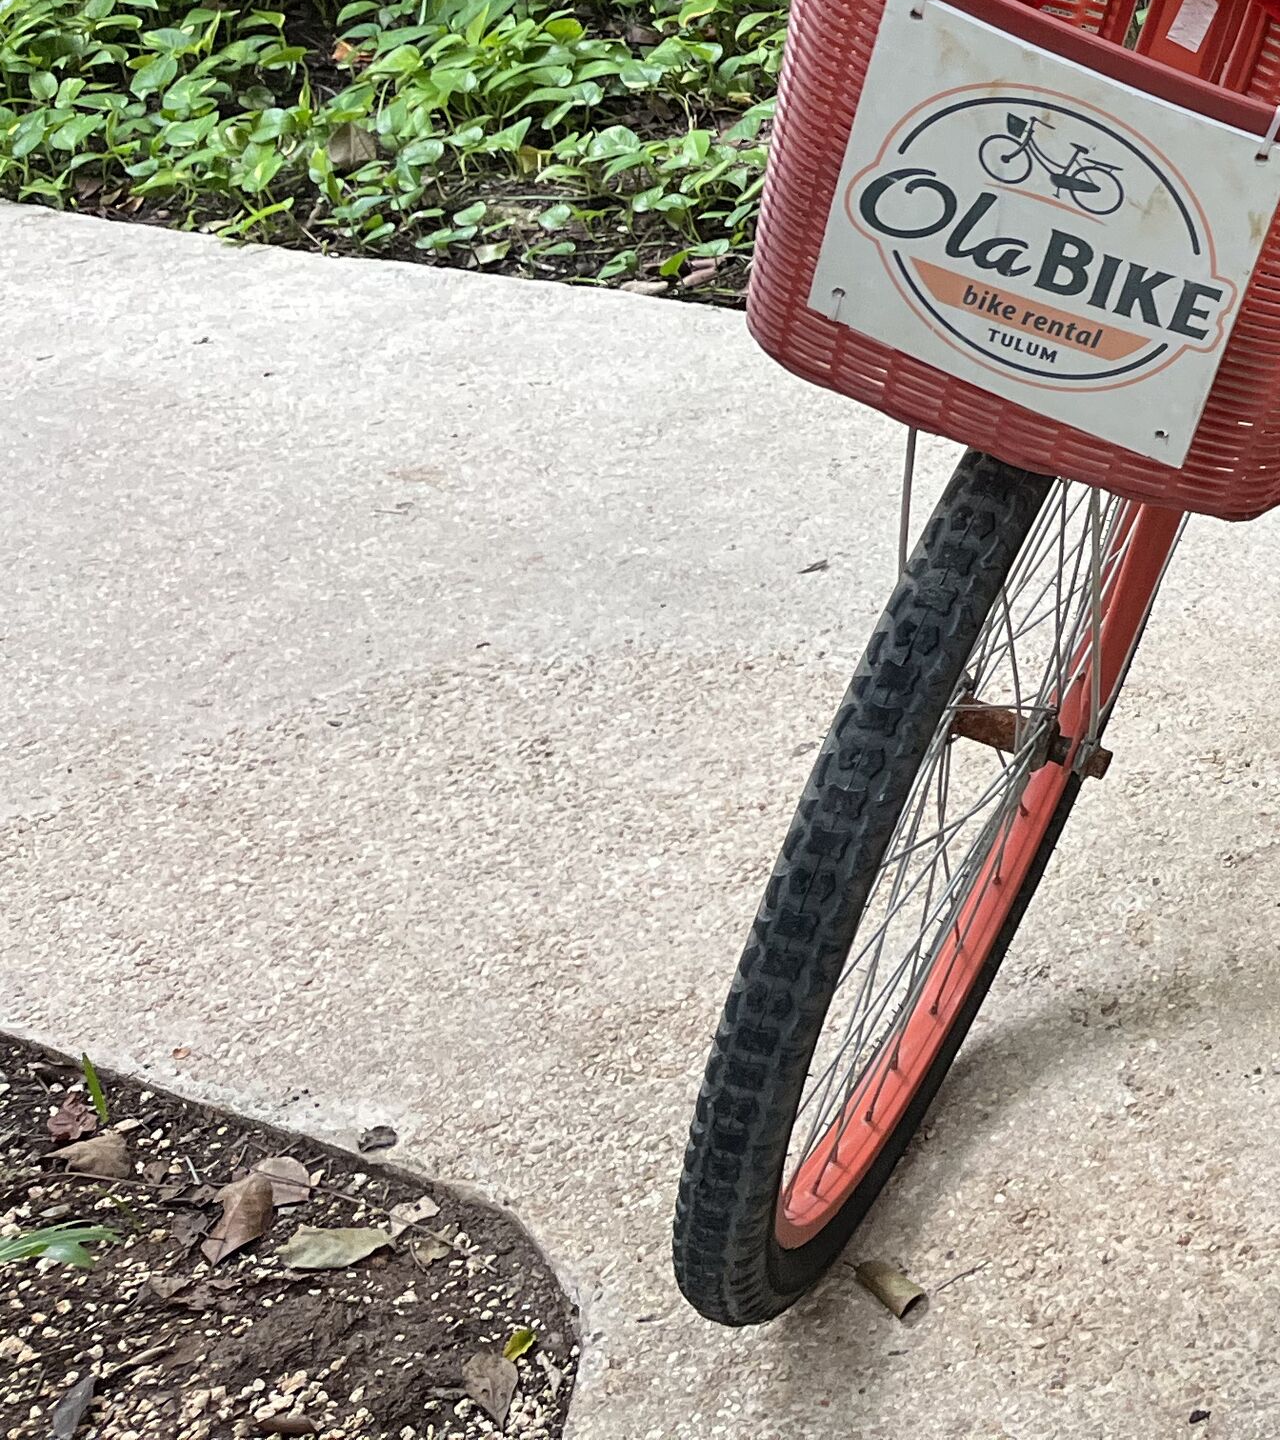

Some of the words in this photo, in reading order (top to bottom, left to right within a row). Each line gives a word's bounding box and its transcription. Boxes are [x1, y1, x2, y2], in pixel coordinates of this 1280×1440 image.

[962, 284, 1017, 322] bike
[1021, 309, 1104, 349] rental
[987, 327, 1059, 364] TULUM
